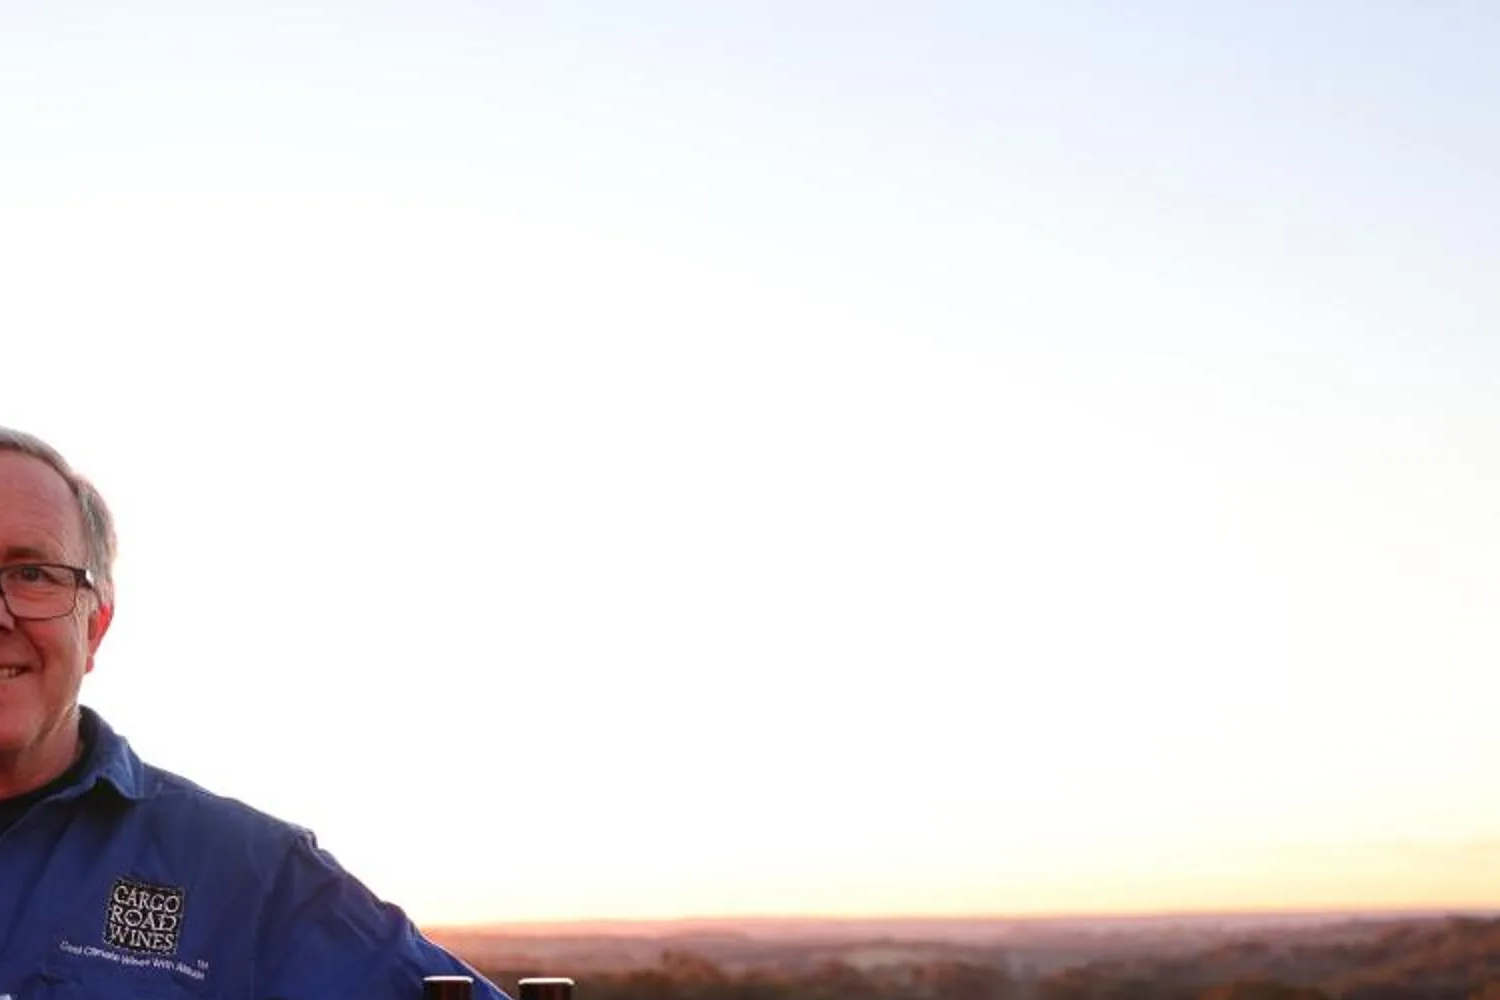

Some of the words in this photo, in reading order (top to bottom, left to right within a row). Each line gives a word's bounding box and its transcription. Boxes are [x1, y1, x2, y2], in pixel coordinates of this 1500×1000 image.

[113, 885, 180, 913] CARGO
[110, 904, 177, 931] ROAD
[109, 923, 175, 950] WINES
